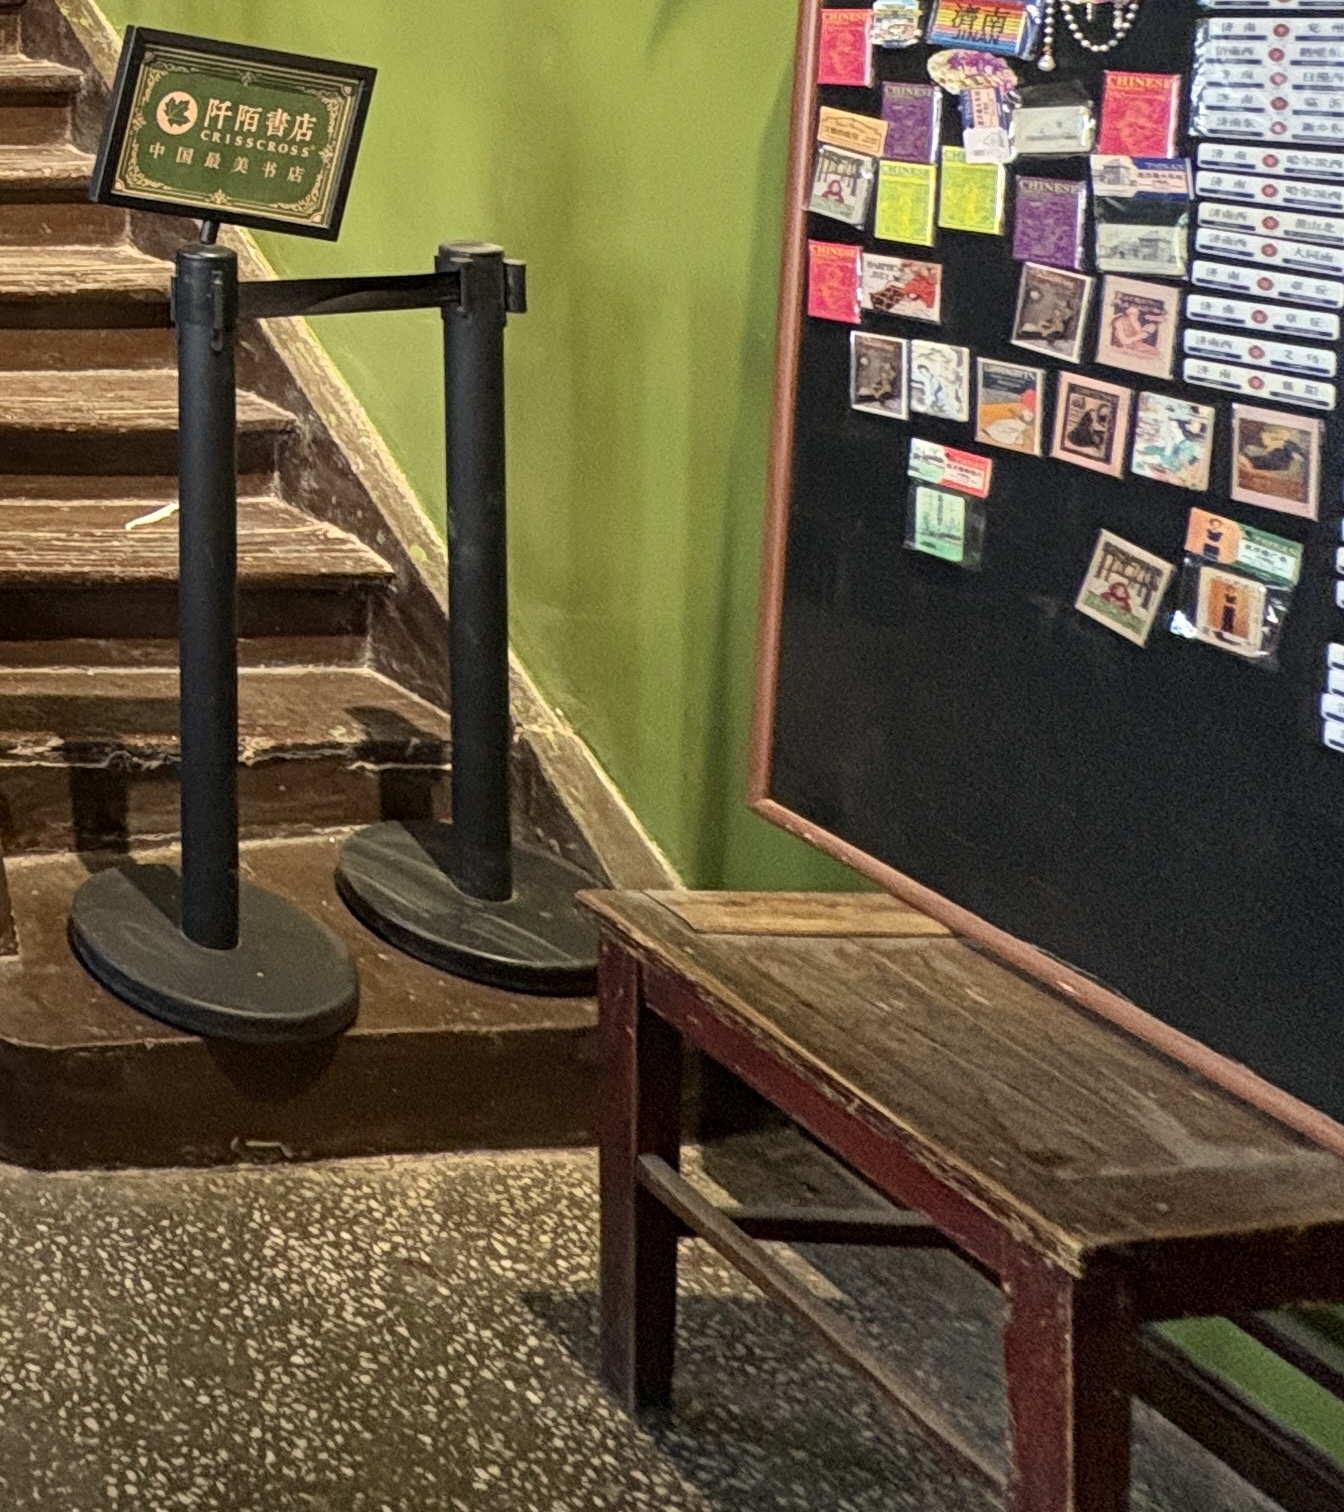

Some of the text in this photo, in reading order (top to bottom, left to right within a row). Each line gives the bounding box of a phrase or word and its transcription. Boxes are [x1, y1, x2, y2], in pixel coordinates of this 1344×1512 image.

[204, 98, 317, 142] 阡陌書店
[149, 142, 305, 183] 中国最美书店
[200, 130, 311, 158] CRISSCROSS
